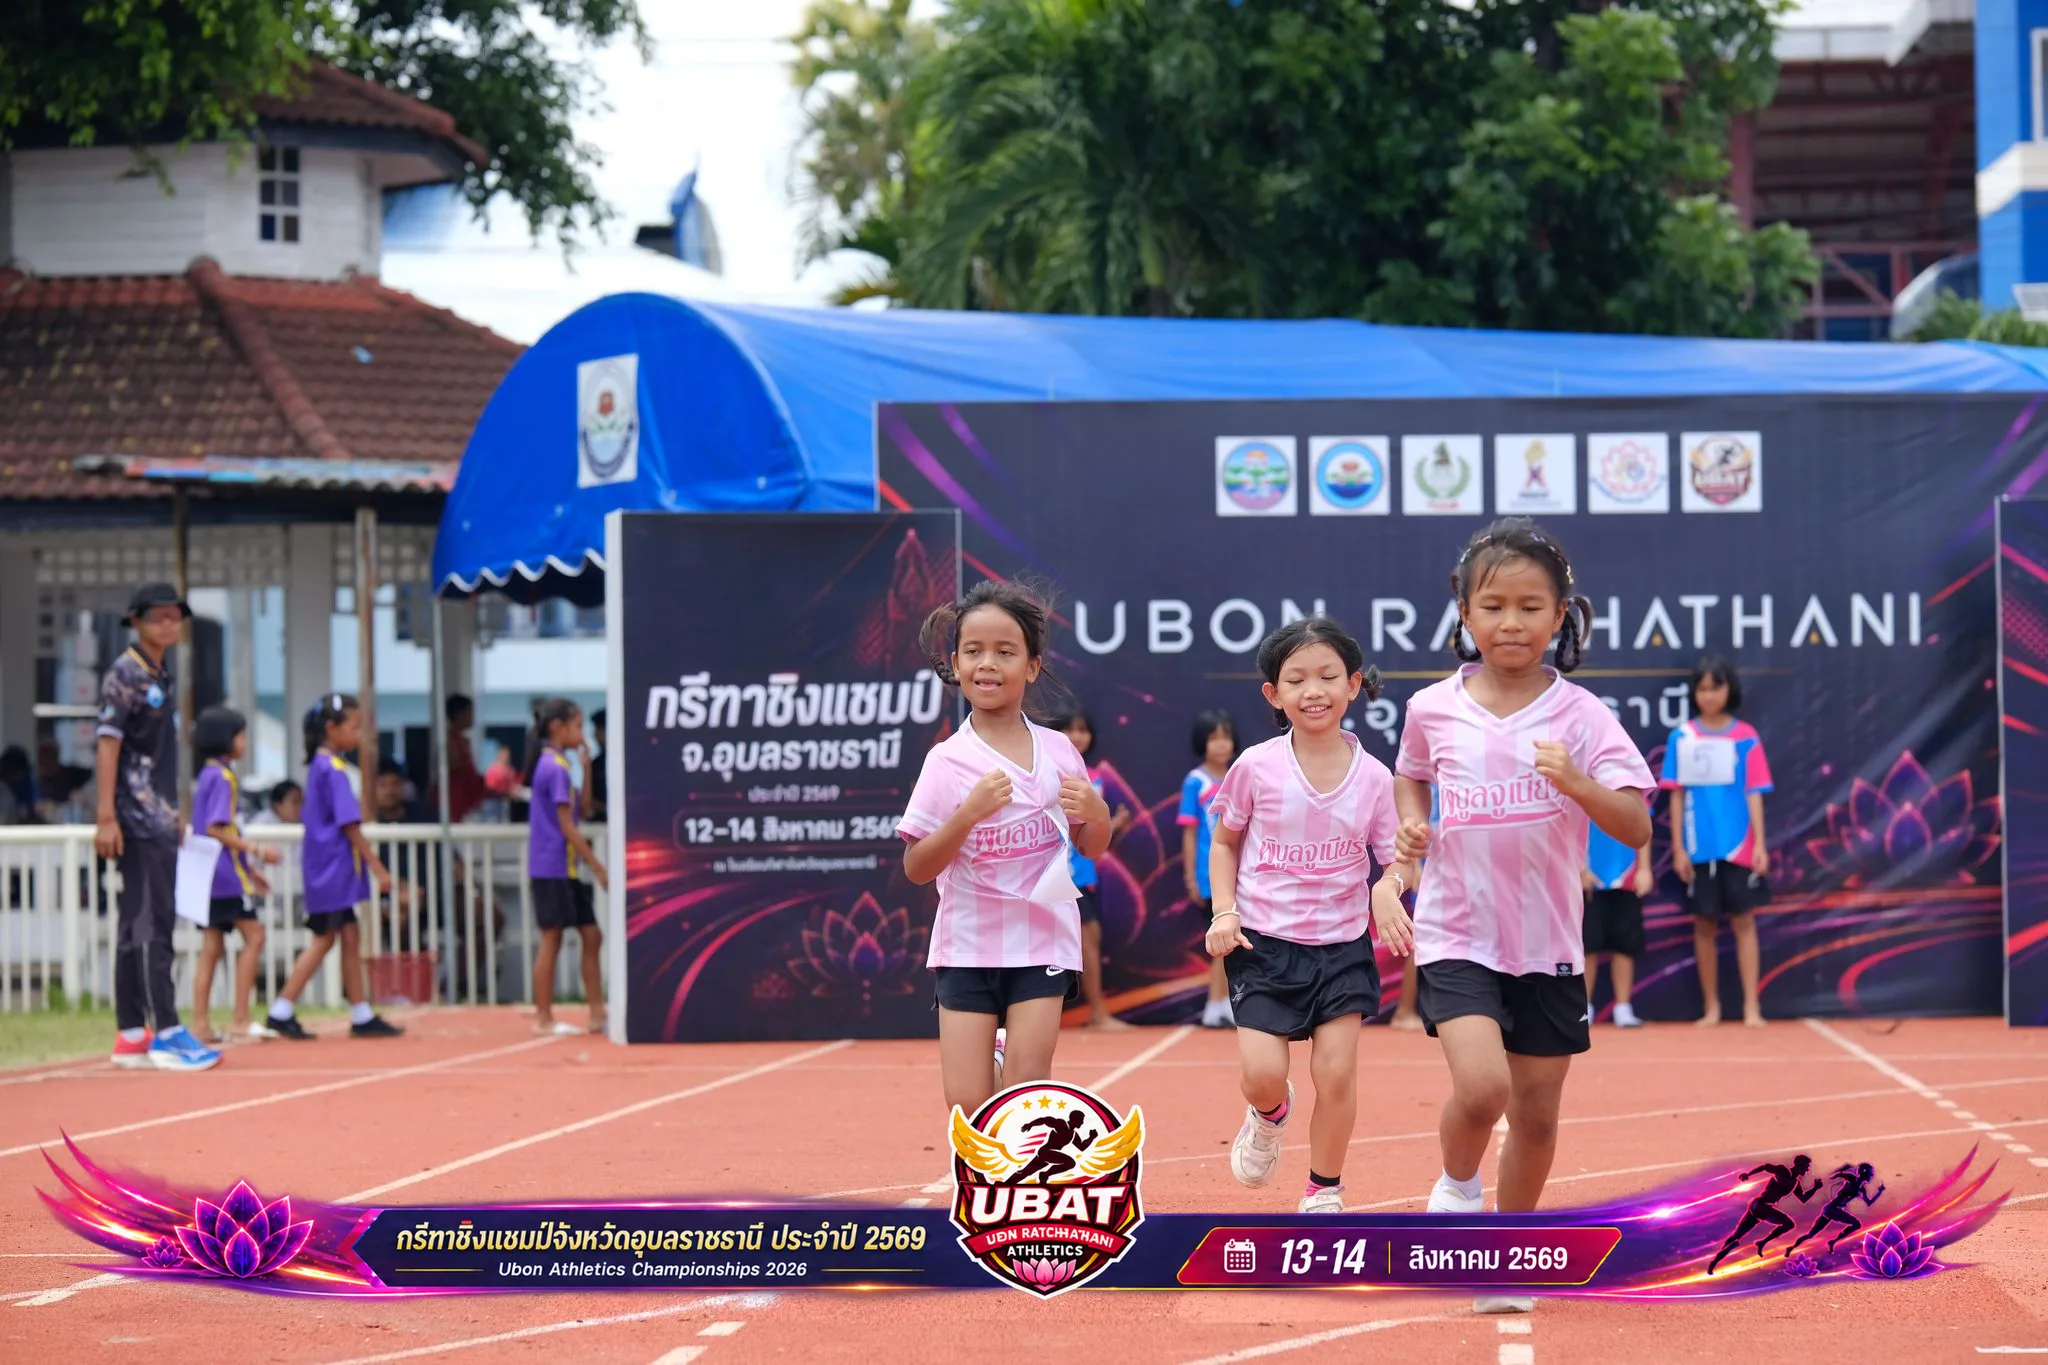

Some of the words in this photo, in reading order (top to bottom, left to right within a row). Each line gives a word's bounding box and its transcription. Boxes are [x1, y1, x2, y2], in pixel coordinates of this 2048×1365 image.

[1372, 593, 1922, 653] RAHATHANI
[645, 670, 943, 729] กรีฑาชิงแชมป์
[682, 729, 902, 782] จ.อุบลราชธานี
[762, 816, 844, 841] สิงหาคม
